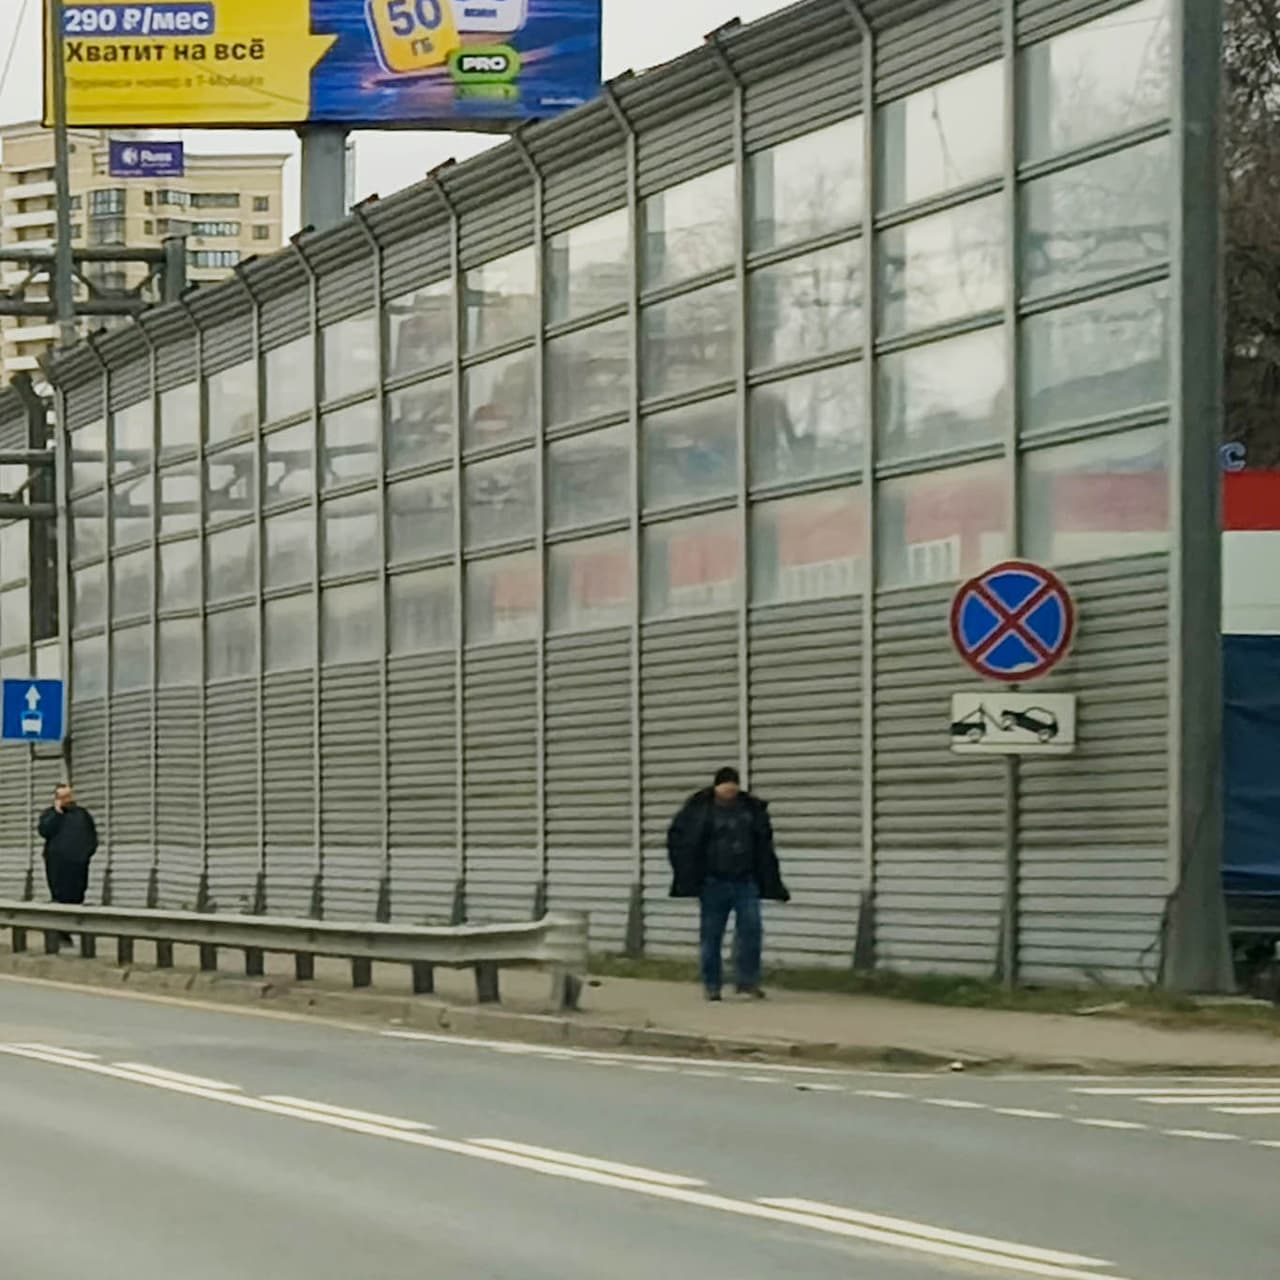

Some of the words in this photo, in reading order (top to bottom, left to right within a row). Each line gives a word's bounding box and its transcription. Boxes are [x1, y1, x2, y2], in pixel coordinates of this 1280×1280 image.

[64, 8, 117, 32] 290
[66, 41, 164, 63] Хватит
[174, 43, 207, 61] на
[214, 38, 265, 61] всё
[411, 37, 434, 57] ГБ
[462, 56, 507, 70] PRO
